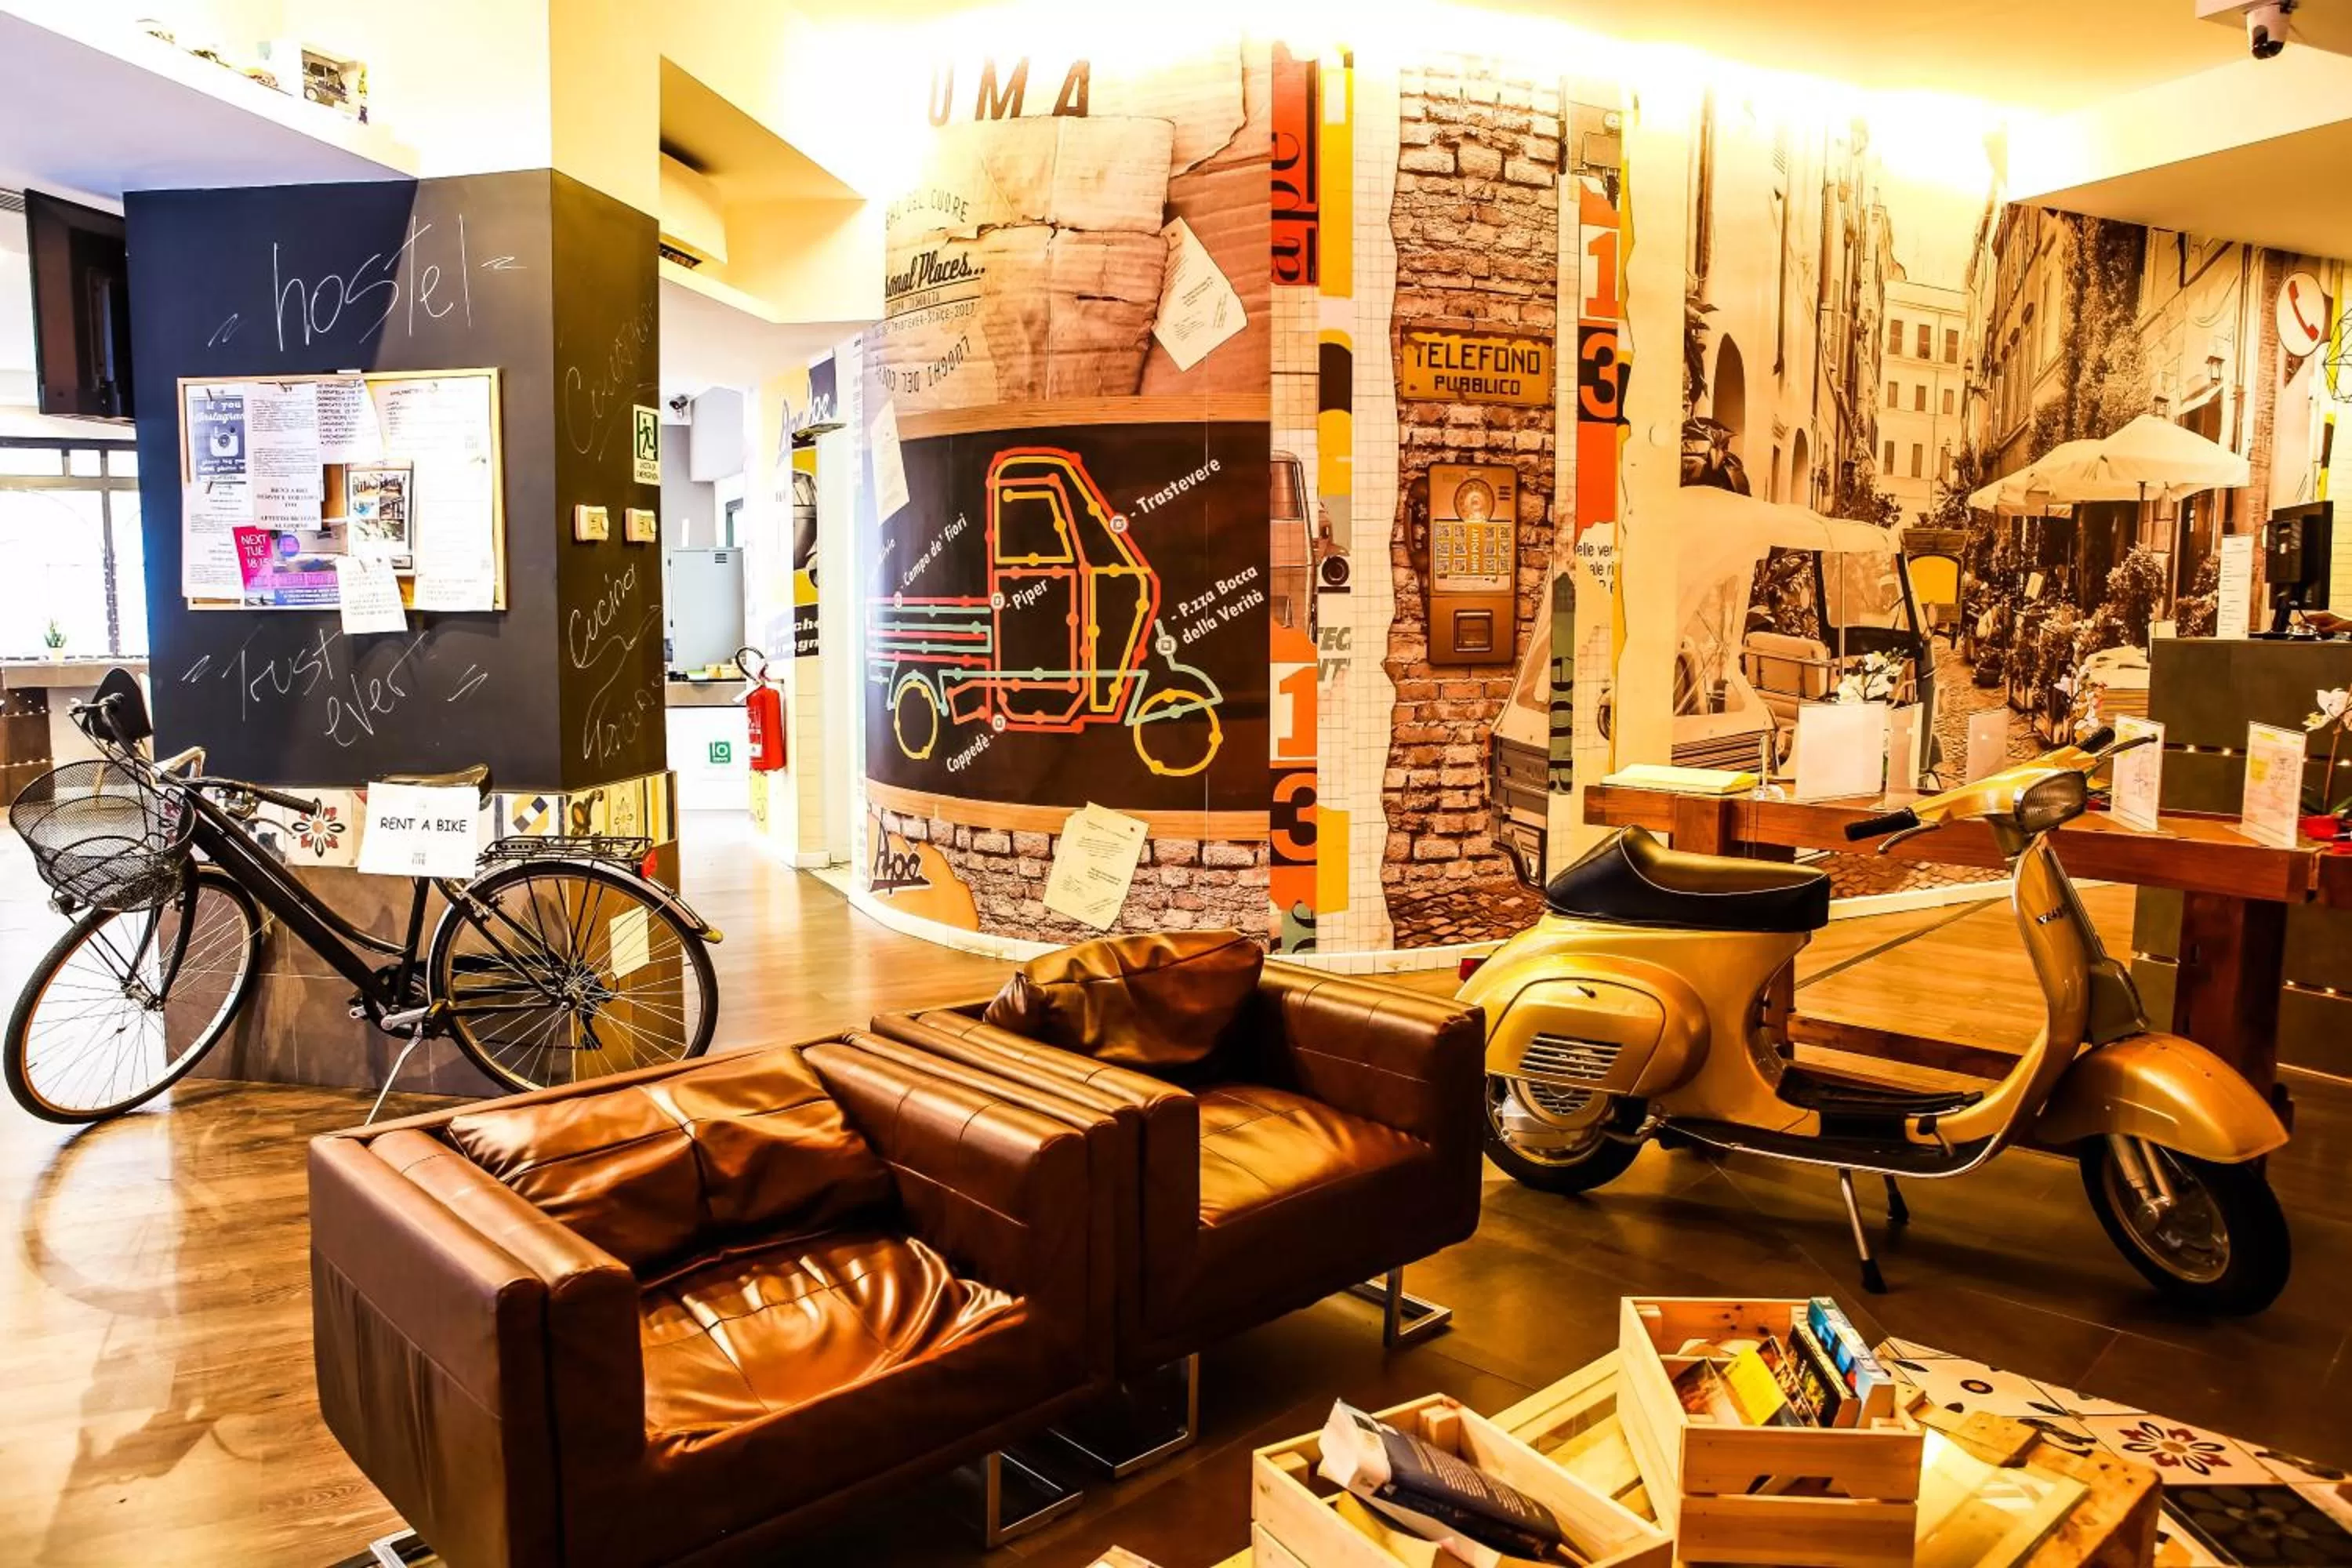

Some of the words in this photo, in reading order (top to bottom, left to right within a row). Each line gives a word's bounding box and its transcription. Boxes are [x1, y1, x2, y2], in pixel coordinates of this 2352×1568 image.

[273, 214, 474, 352] hostel
[1416, 341, 1541, 376] TELEFONO
[1434, 374, 1521, 395] PUBBLICO
[1581, 332, 1618, 419] 3
[220, 402, 242, 412] you
[1137, 458, 1221, 514] Trastevere
[241, 535, 267, 546] NEXT
[245, 546, 265, 557] TUE
[903, 554, 931, 586] Campo
[944, 512, 967, 542] fiori
[569, 562, 636, 669] Cucina
[1012, 580, 1049, 612] Piper
[1178, 589, 1215, 619] P.zza
[1216, 564, 1258, 597] Bocca
[1182, 618, 1218, 644] della
[1217, 589, 1265, 625] Verità
[222, 625, 342, 721] Trust
[325, 630, 429, 747] ever
[946, 734, 991, 773] Coppedè
[379, 817, 416, 830] RENT
[422, 819, 430, 831] A
[437, 819, 467, 833] BIKE
[1272, 773, 1317, 860] 3
